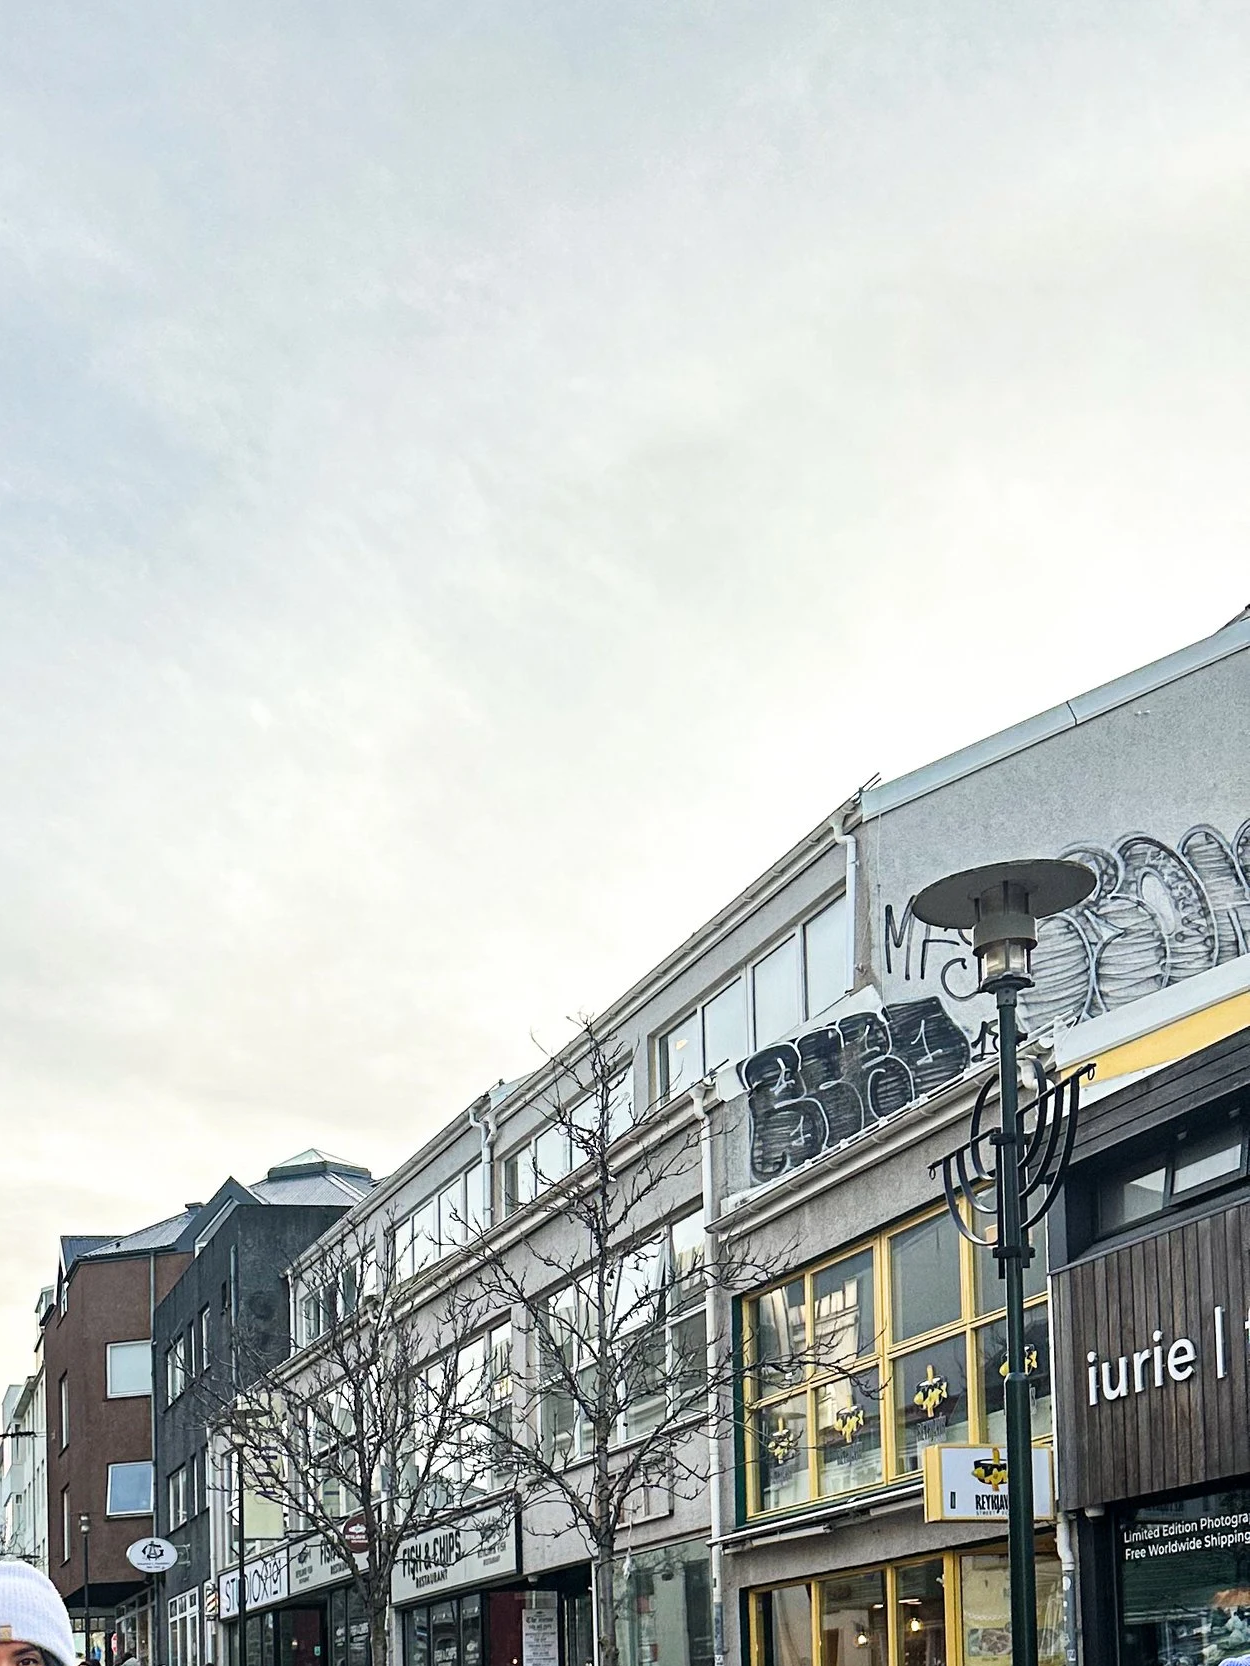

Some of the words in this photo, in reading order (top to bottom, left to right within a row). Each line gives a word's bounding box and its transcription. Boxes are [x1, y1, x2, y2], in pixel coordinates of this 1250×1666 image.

[1087, 1329, 1197, 1406] iurie
[975, 1494, 1009, 1513] REYKJAV
[1123, 1527, 1160, 1543] Limited
[1162, 1521, 1198, 1537] Edition
[1200, 1512, 1250, 1530] Photogra
[402, 1542, 422, 1581] FISH
[424, 1542, 432, 1570] &
[433, 1530, 461, 1566] CHIPS
[1125, 1548, 1146, 1560] Free
[1148, 1537, 1202, 1557] Worldwide
[1204, 1529, 1250, 1548] Shipping
